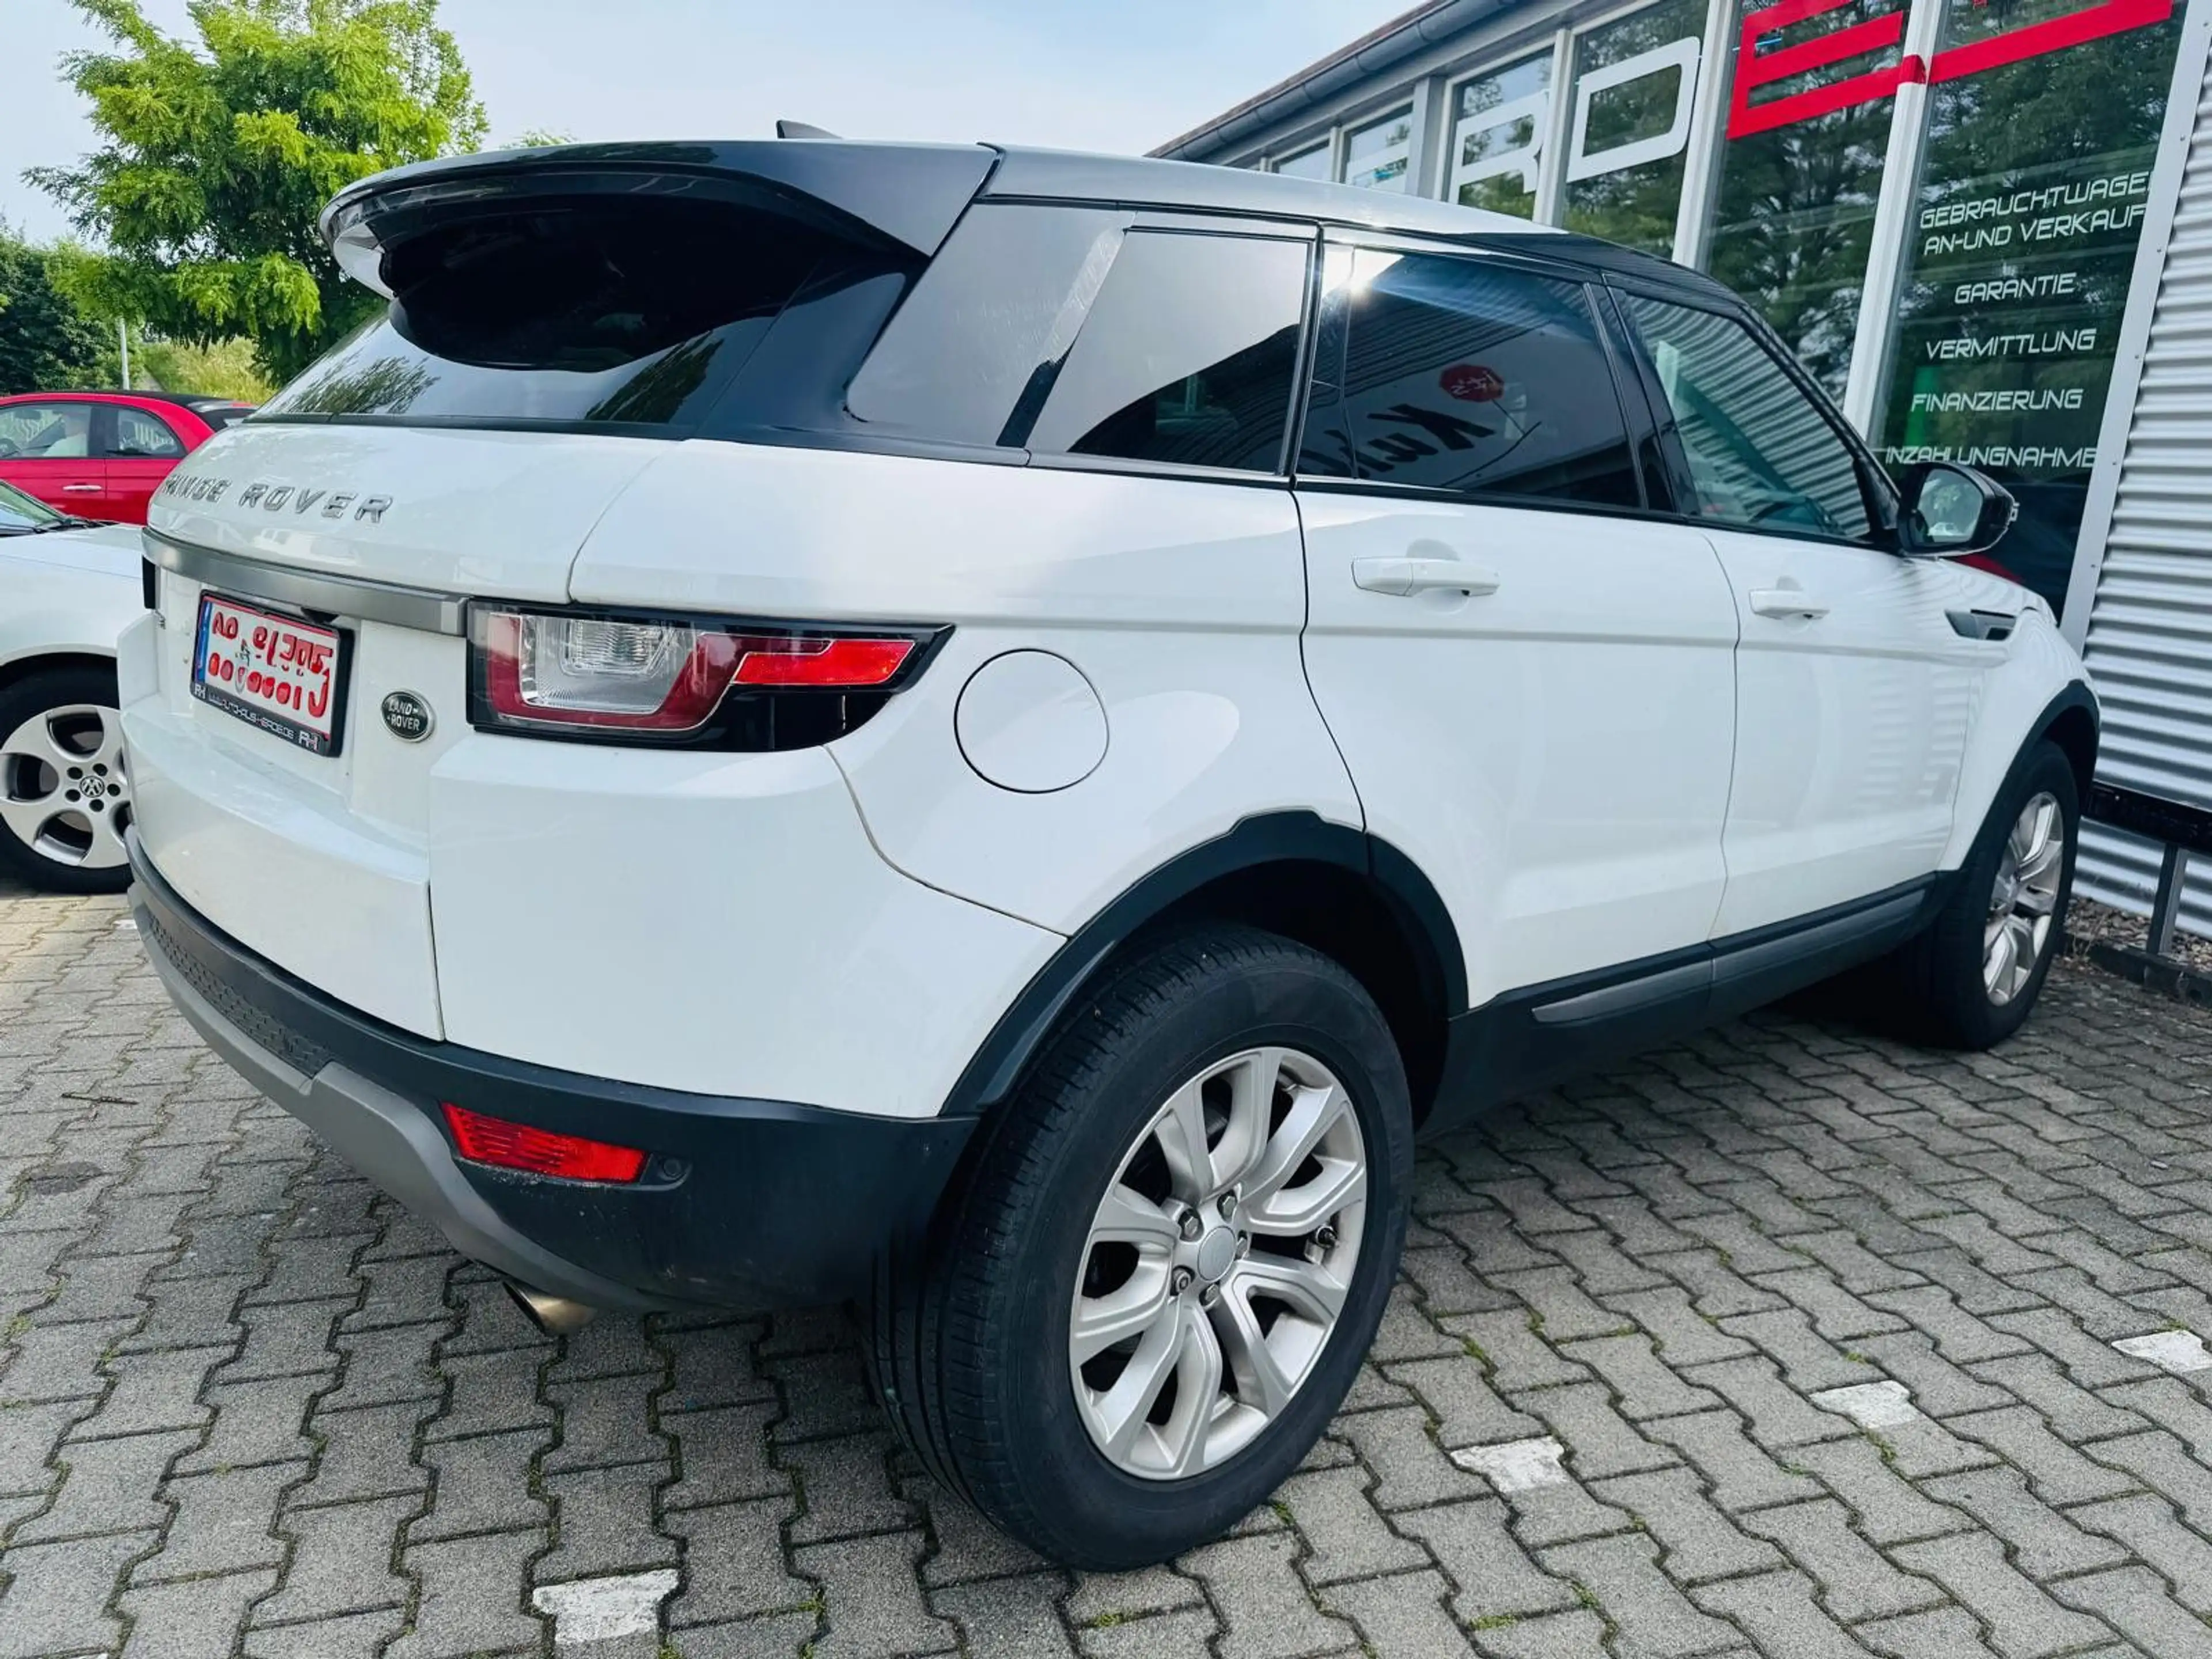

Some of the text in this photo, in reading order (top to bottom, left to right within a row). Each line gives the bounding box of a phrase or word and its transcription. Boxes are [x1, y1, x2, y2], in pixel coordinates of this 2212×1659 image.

[1919, 171, 2150, 230] GEBRAUCHTWAGE
[1923, 202, 2147, 256] AN-UND VERKAUF
[1955, 272, 2077, 305] GARANTIE
[1926, 328, 2097, 361] VERMITTLUNG
[1911, 388, 2085, 413] FINANZIERUNG
[237, 482, 393, 524] ROVER
